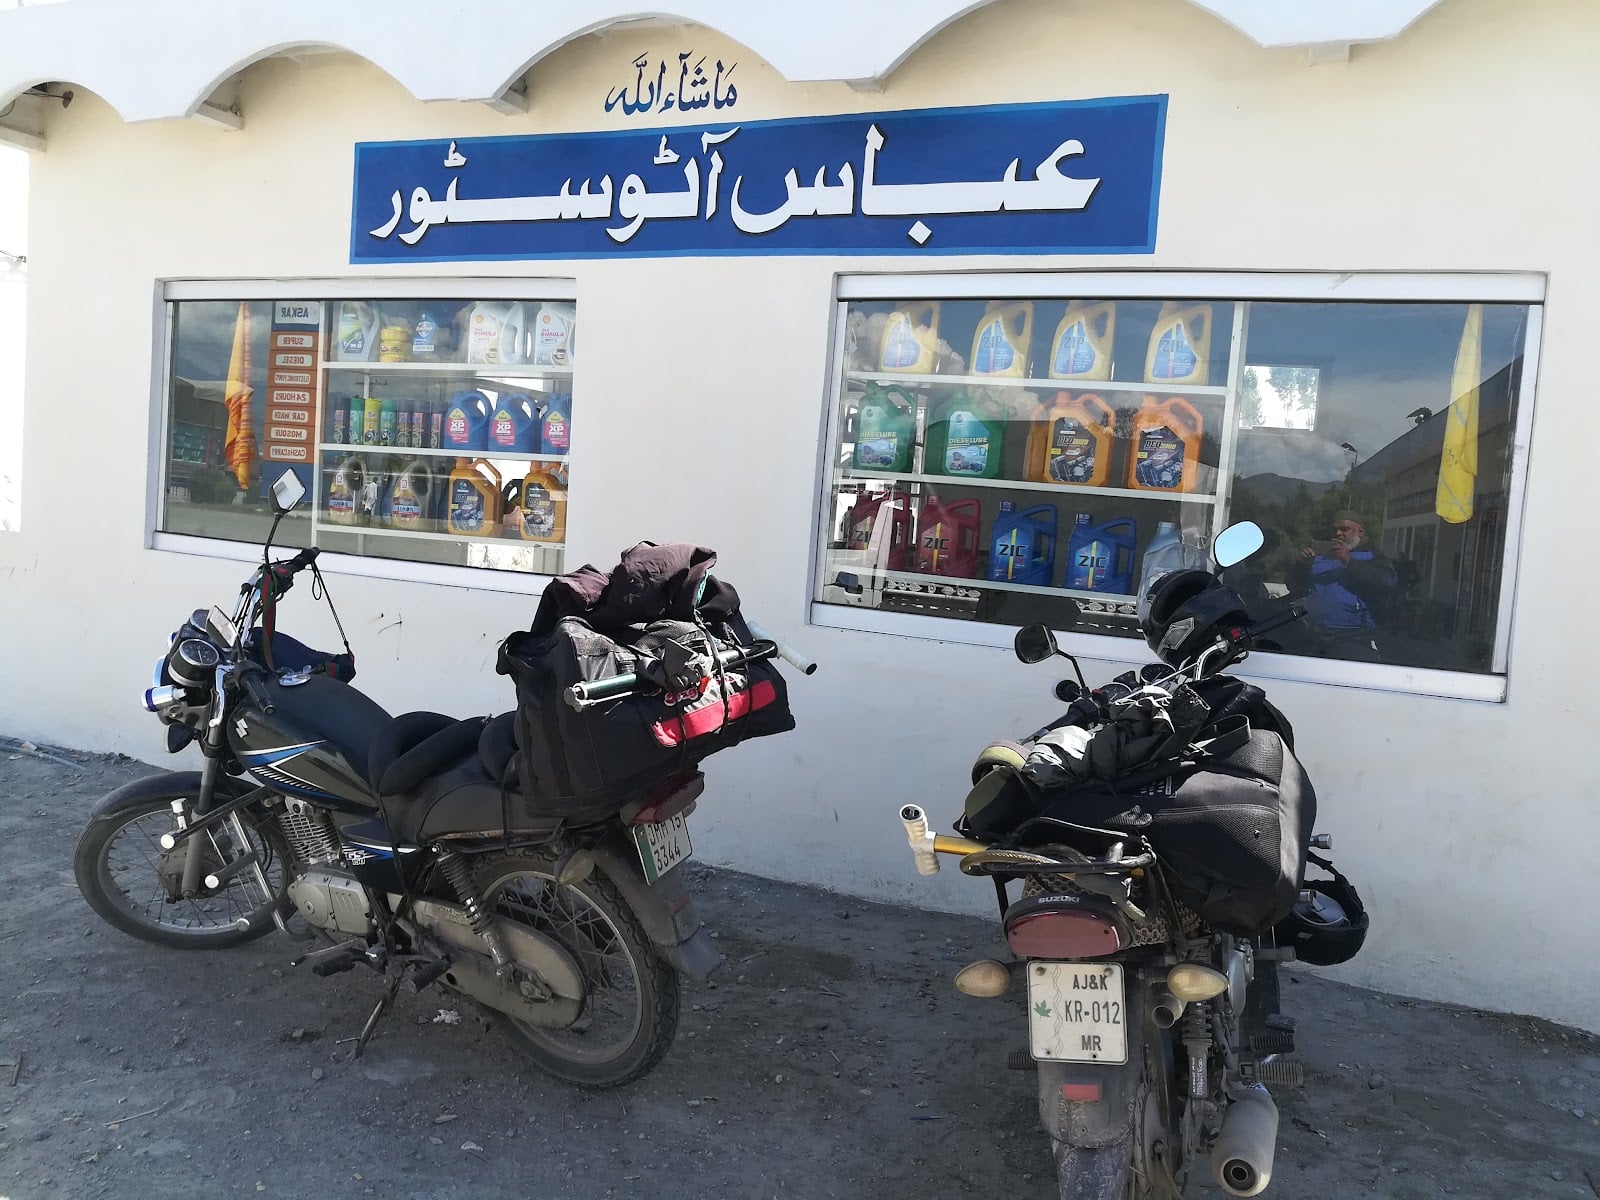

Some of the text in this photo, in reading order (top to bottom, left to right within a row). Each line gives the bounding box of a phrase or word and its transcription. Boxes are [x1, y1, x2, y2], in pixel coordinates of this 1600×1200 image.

[730, 124, 1101, 246] عباس
[369, 141, 613, 246] سٹور
[924, 537, 951, 550] ZIC
[998, 543, 1027, 557] ZIC
[1078, 555, 1107, 568] ZIC
[654, 837, 681, 872] 3344
[1038, 895, 1080, 904] SUZUKI
[1072, 974, 1108, 991] AJ&K
[1064, 1000, 1121, 1025] KR-012
[1081, 1035, 1102, 1051] MR
